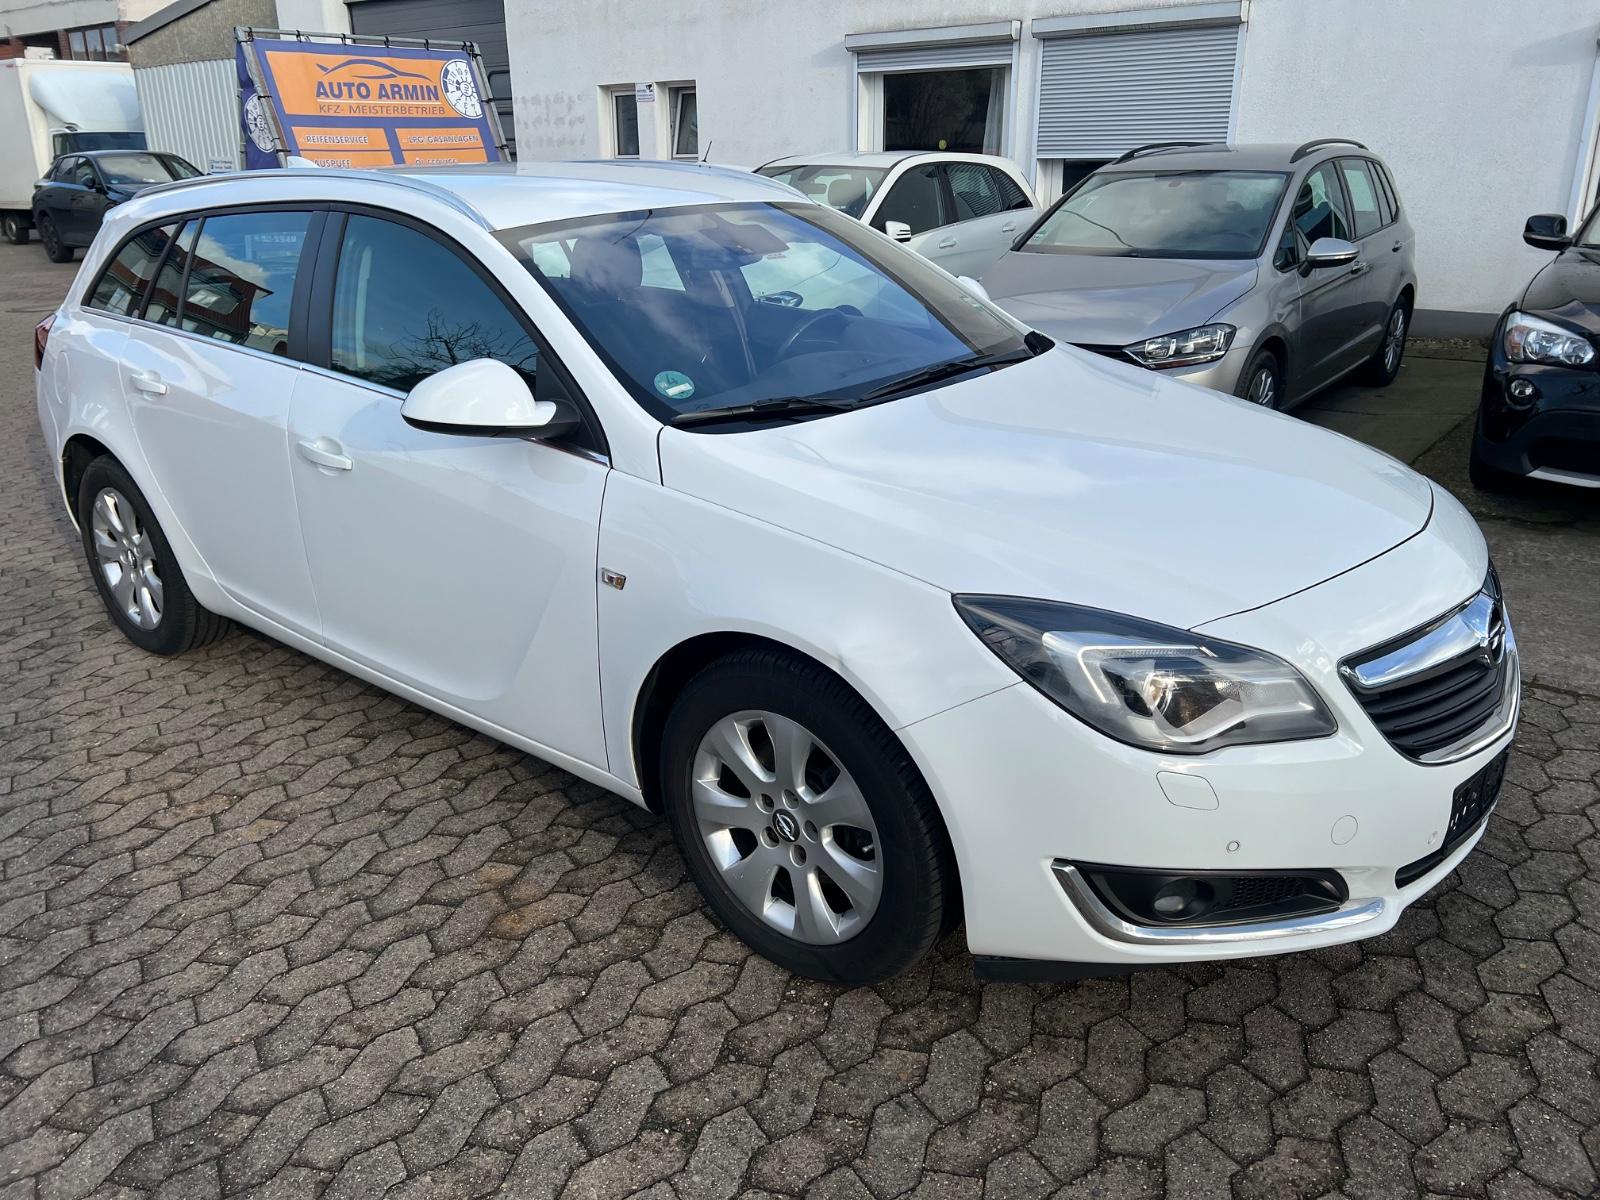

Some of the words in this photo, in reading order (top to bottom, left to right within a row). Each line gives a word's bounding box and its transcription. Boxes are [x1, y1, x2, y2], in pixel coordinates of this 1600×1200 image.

[316, 81, 371, 99] AUTO
[378, 83, 439, 100] ARMIN
[349, 105, 446, 115] MEISTERBETRIEB
[306, 135, 368, 144] REIFENSERVICE
